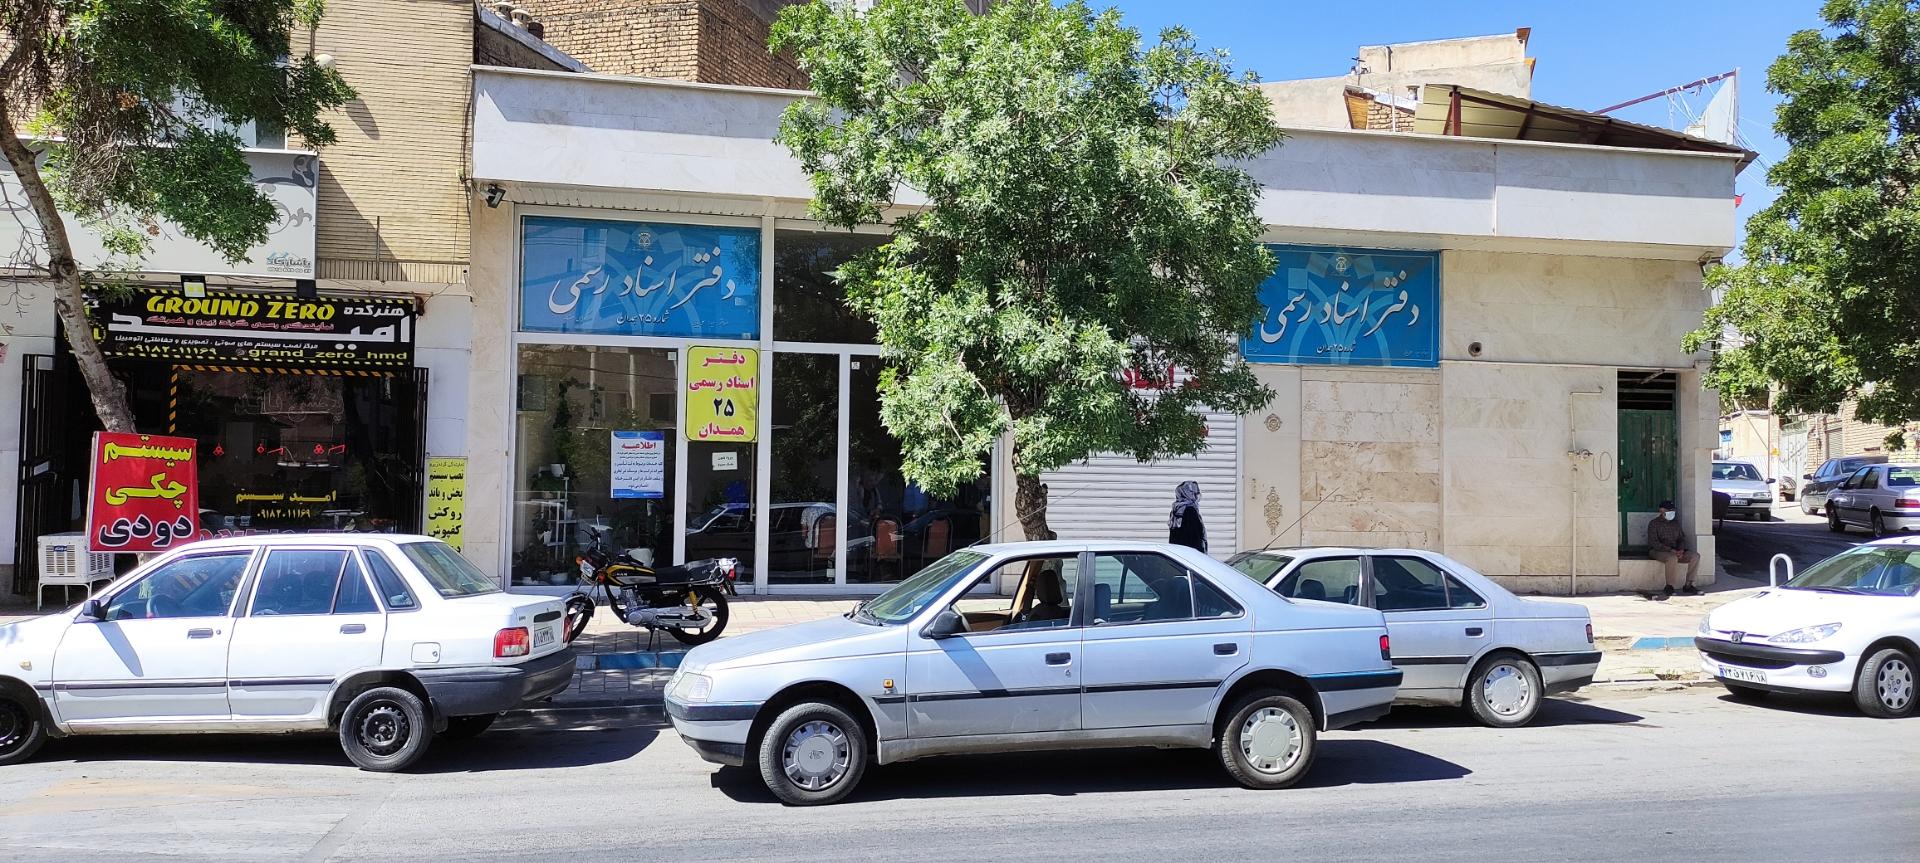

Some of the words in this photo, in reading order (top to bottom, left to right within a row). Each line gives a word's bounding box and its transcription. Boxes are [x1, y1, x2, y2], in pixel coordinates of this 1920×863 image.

[618, 255, 677, 297] اسناد
[670, 246, 736, 310] دفتر
[548, 264, 610, 314] رسمی
[146, 295, 259, 317] GROUND
[266, 301, 335, 320] ZERO
[1319, 280, 1369, 326] اسناد
[1363, 270, 1420, 337] دفتر
[343, 304, 405, 318] هنرکده
[1260, 290, 1313, 344] رسمی
[107, 311, 411, 351] امید
[250, 320, 280, 330] رسمی
[281, 321, 335, 332] نمایندگی
[115, 334, 143, 342] اتومبیل
[144, 335, 174, 344] حفاظتی
[181, 337, 210, 346] تصویری
[214, 337, 236, 347] صوتی
[237, 339, 253, 347] های
[253, 339, 281, 349] سیستم
[282, 341, 302, 349] نصب
[248, 349, 408, 360] grand_zero_hmd
[702, 350, 746, 367] دفتر
[688, 377, 723, 392] رسمی
[726, 375, 755, 389] اسناد
[713, 397, 735, 417] ۲۵
[698, 421, 745, 439] همدان
[103, 434, 193, 467] سیستم
[621, 441, 656, 451] اطلاعیه
[429, 470, 448, 482] سیستم
[450, 469, 464, 482] نصب
[105, 472, 188, 509] چکی
[236, 488, 285, 505] سیستم
[289, 490, 337, 505] امید
[428, 487, 440, 500] باند
[98, 513, 194, 548] دودی
[427, 525, 462, 539] کفپوش
